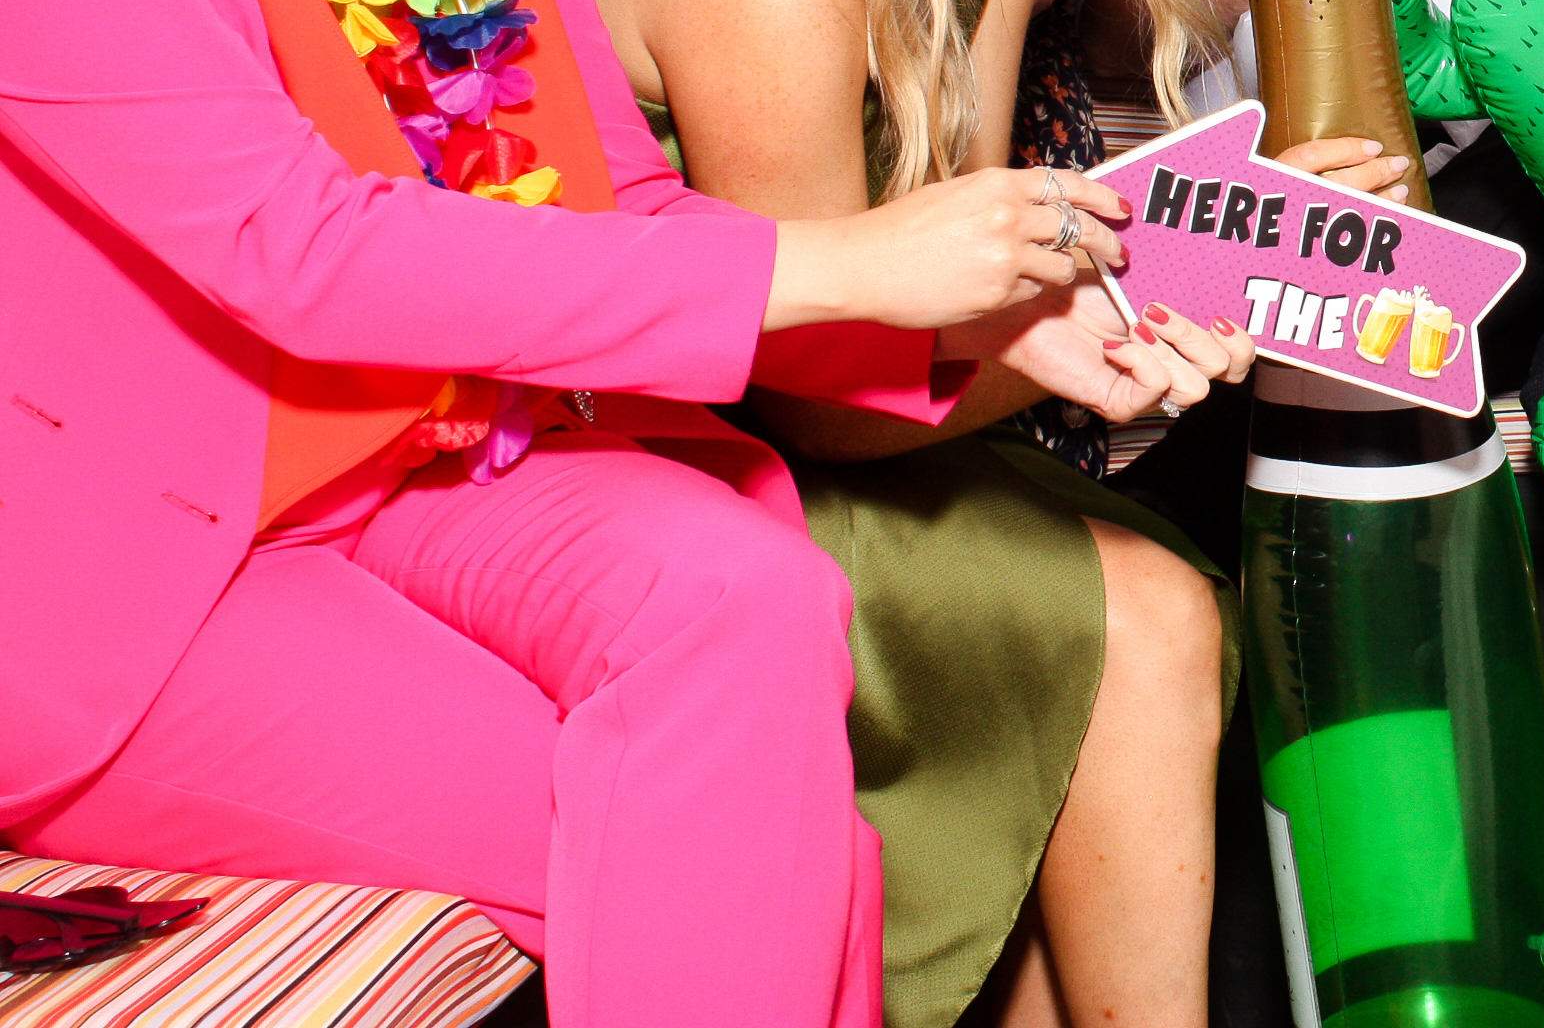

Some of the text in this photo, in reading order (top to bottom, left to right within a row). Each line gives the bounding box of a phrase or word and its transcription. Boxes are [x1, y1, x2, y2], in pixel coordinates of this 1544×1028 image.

[1142, 162, 1403, 276] HERE FOR
[1243, 275, 1352, 351] THE
